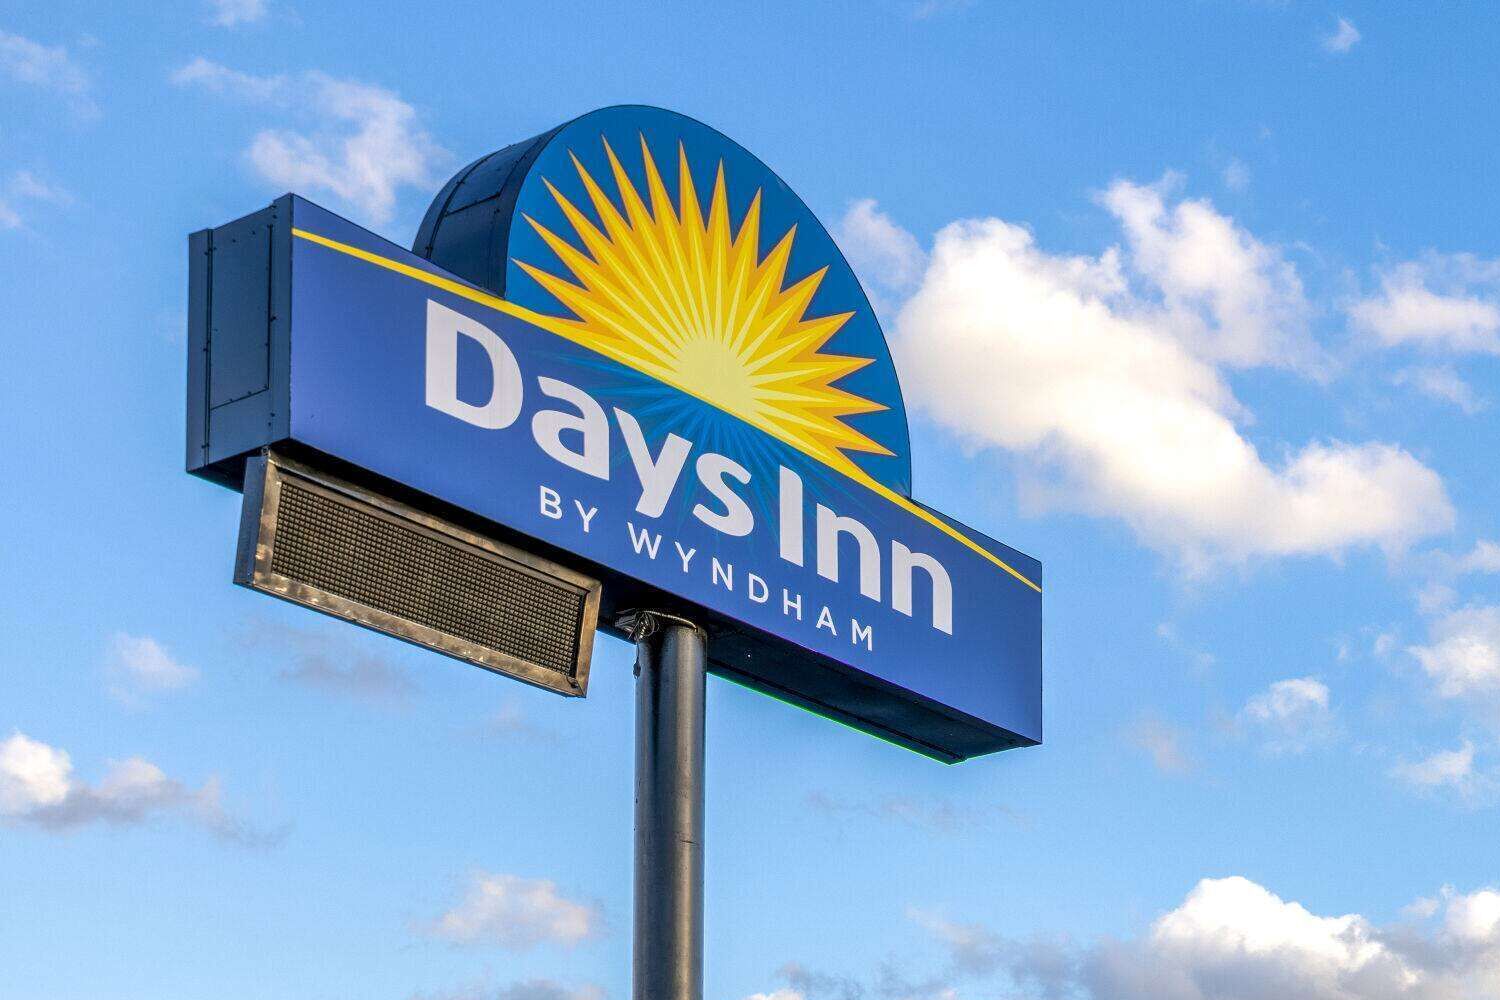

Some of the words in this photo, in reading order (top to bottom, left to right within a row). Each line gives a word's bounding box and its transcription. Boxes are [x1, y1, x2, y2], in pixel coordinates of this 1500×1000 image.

[425, 298, 756, 538] Days
[779, 465, 953, 636] Inn
[539, 485, 599, 534] BY
[627, 521, 875, 652] WYNDHAM
